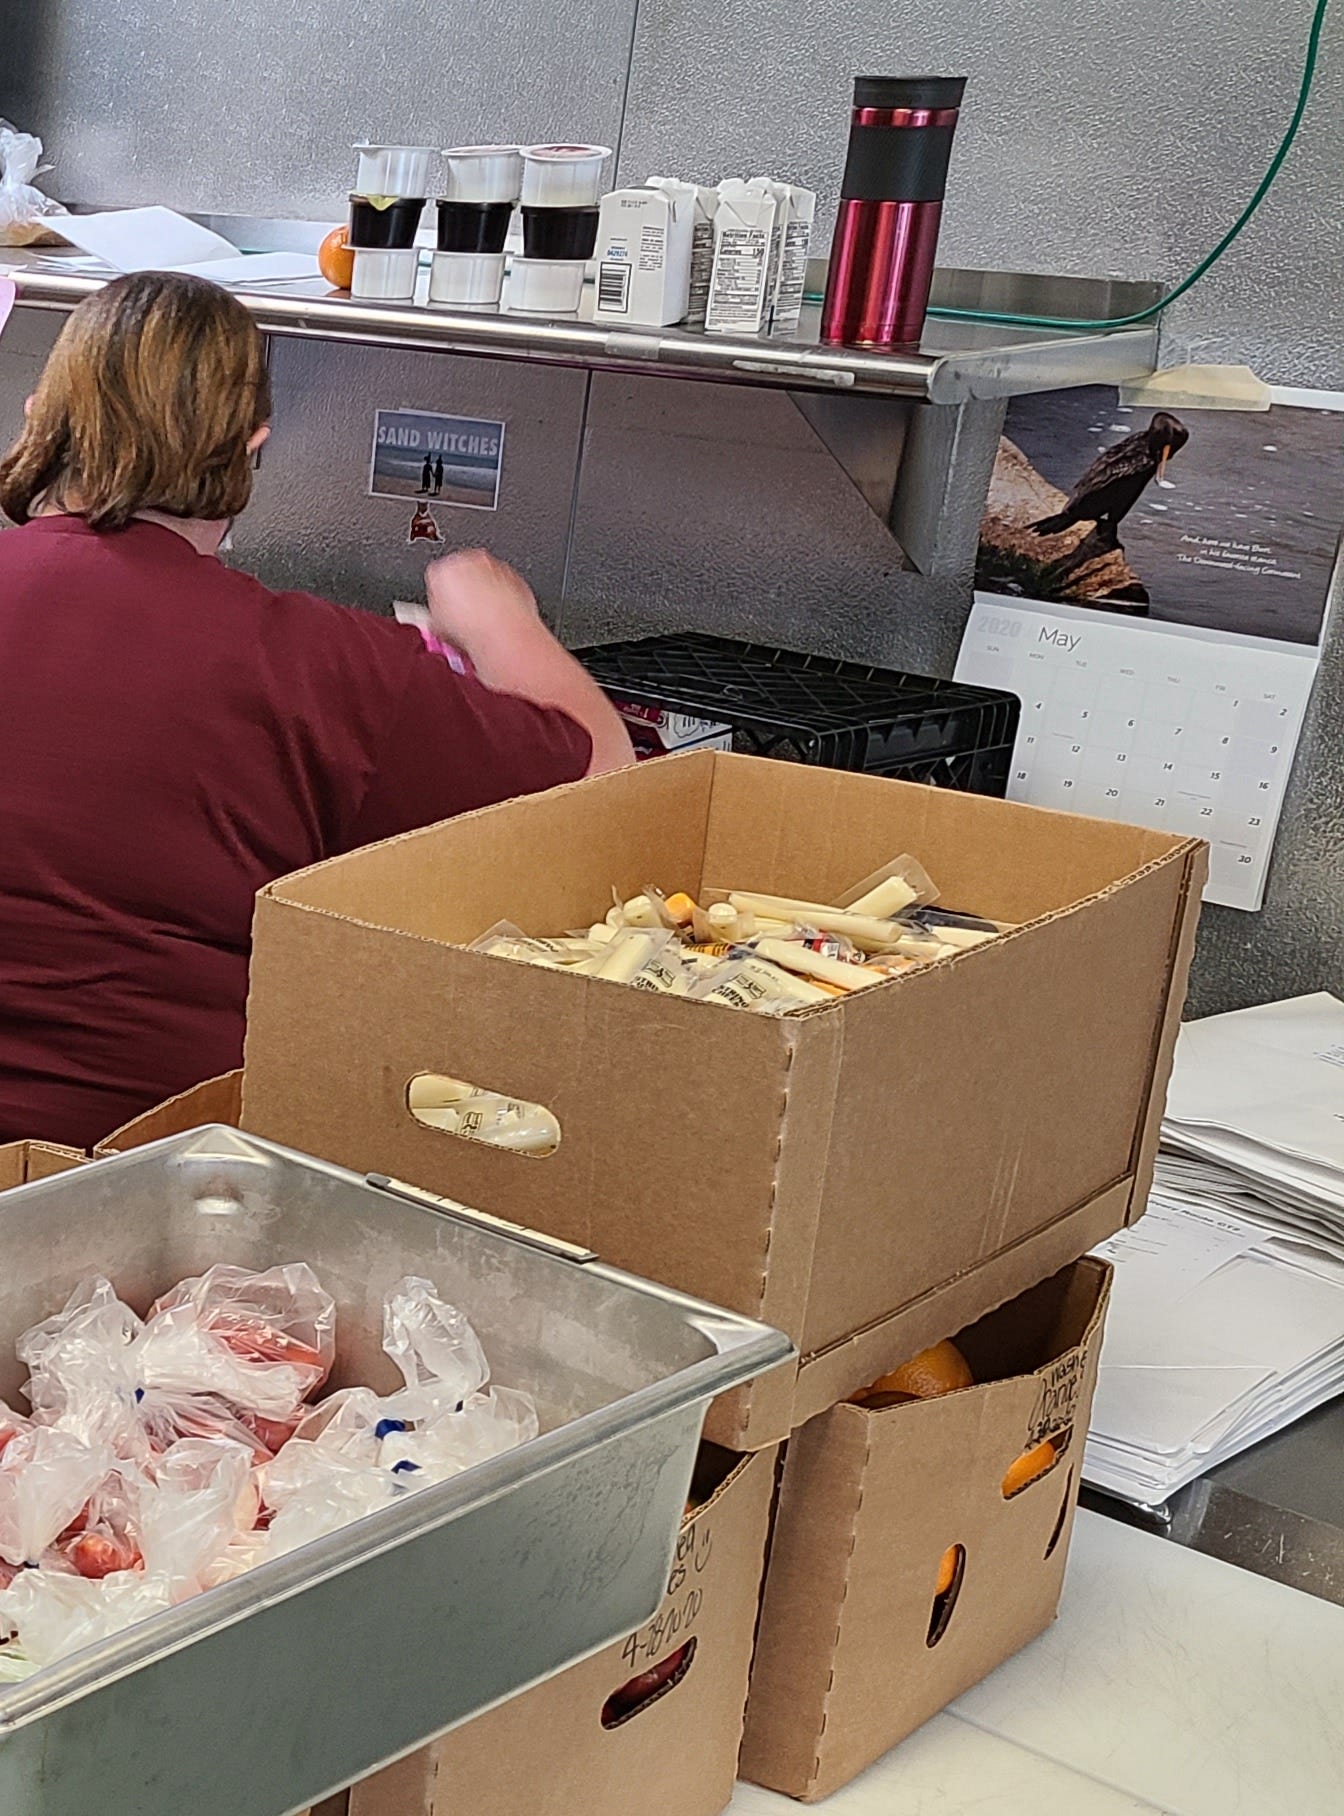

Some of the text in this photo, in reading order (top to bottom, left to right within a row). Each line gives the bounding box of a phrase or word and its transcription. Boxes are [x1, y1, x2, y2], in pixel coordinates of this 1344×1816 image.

[378, 426, 499, 456] SAND WITCHES
[976, 615, 1082, 652] 2020 May
[1279, 708, 1287, 716] 2
[1026, 736, 1035, 744] 11
[1072, 745, 1080, 753] 12
[1210, 771, 1221, 780] 15
[1258, 781, 1269, 790] 16
[1017, 772, 1026, 780] 18
[1105, 788, 1119, 797] 20
[1154, 798, 1165, 807] 21
[1200, 807, 1213, 816] 22
[1248, 817, 1261, 826] 23
[1237, 855, 1252, 864] 30
